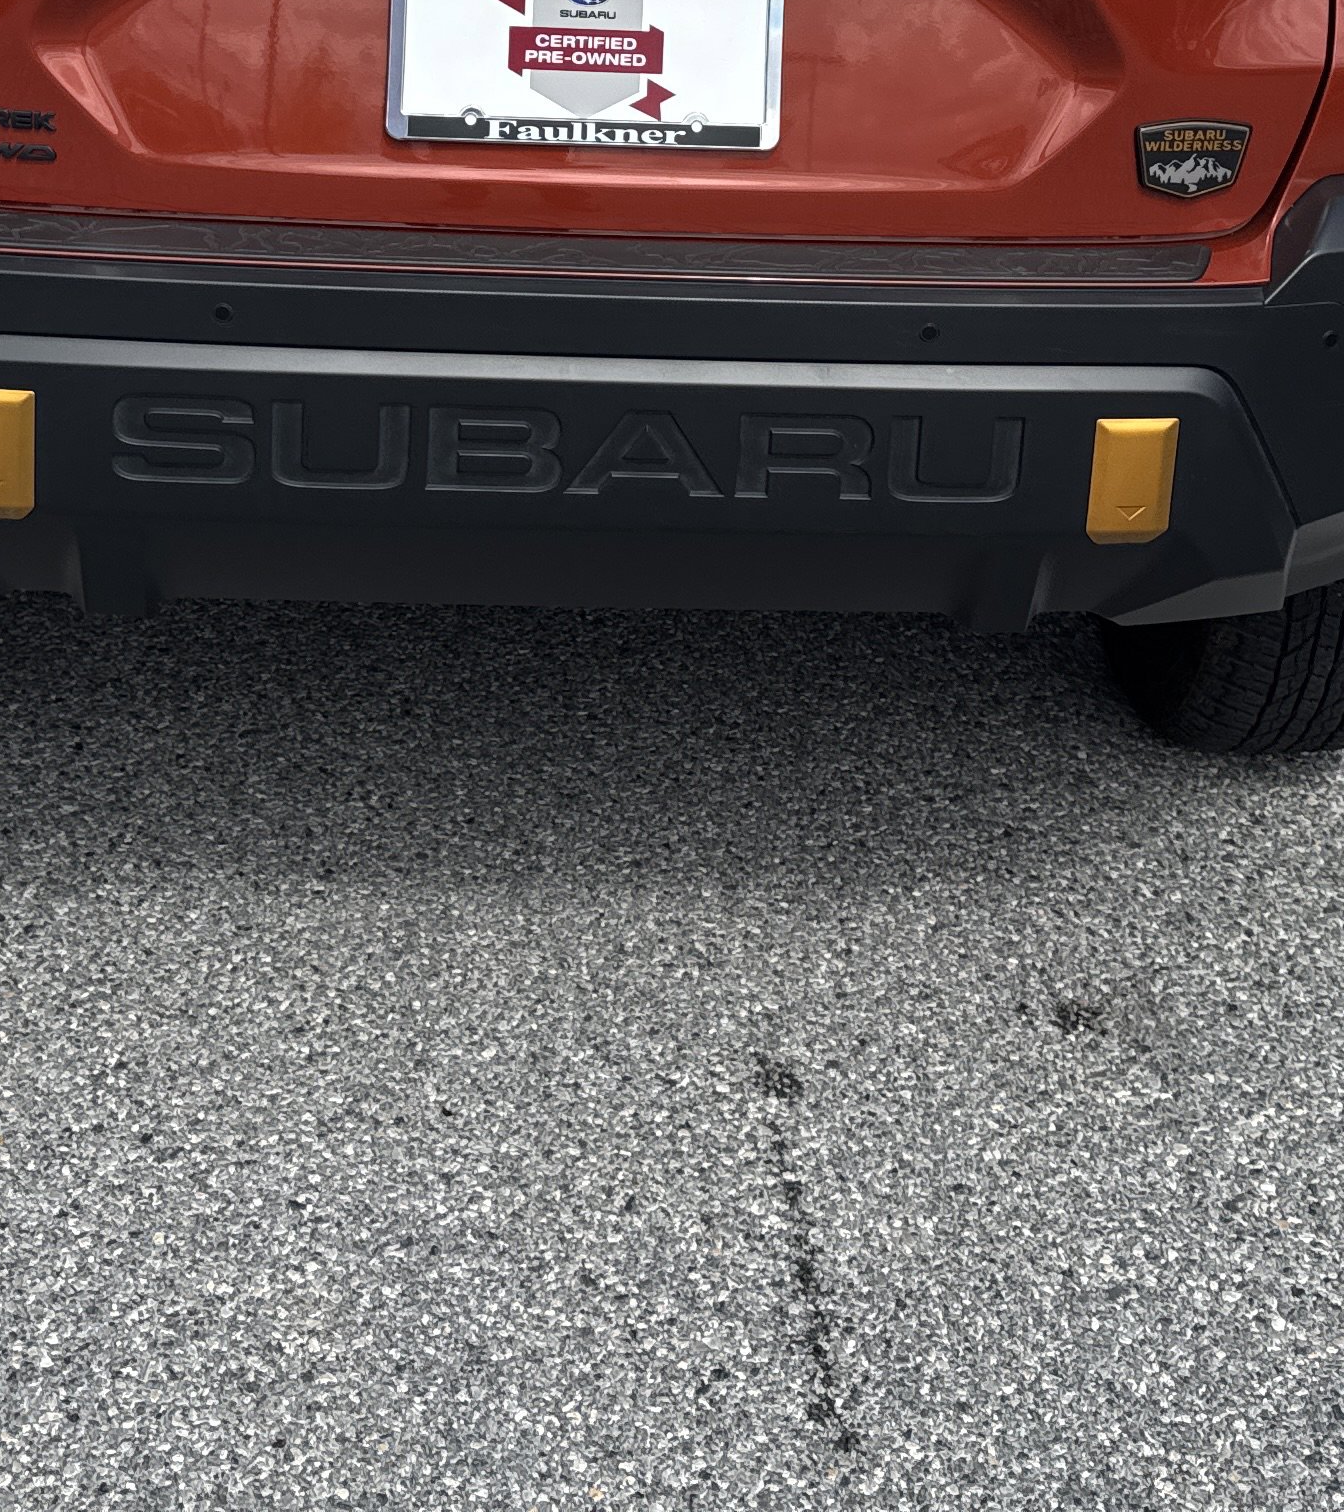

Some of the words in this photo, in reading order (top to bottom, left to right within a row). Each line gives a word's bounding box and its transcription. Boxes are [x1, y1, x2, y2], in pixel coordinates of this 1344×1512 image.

[559, 9, 616, 20] SUBARU
[535, 33, 637, 51] CERTIFIED
[524, 49, 647, 67] PRE-OWNED
[484, 119, 687, 145] Faulkner
[1163, 129, 1226, 141] SUBARU
[1144, 139, 1242, 152] WILDERNESS
[111, 391, 1027, 503] SUBARU
